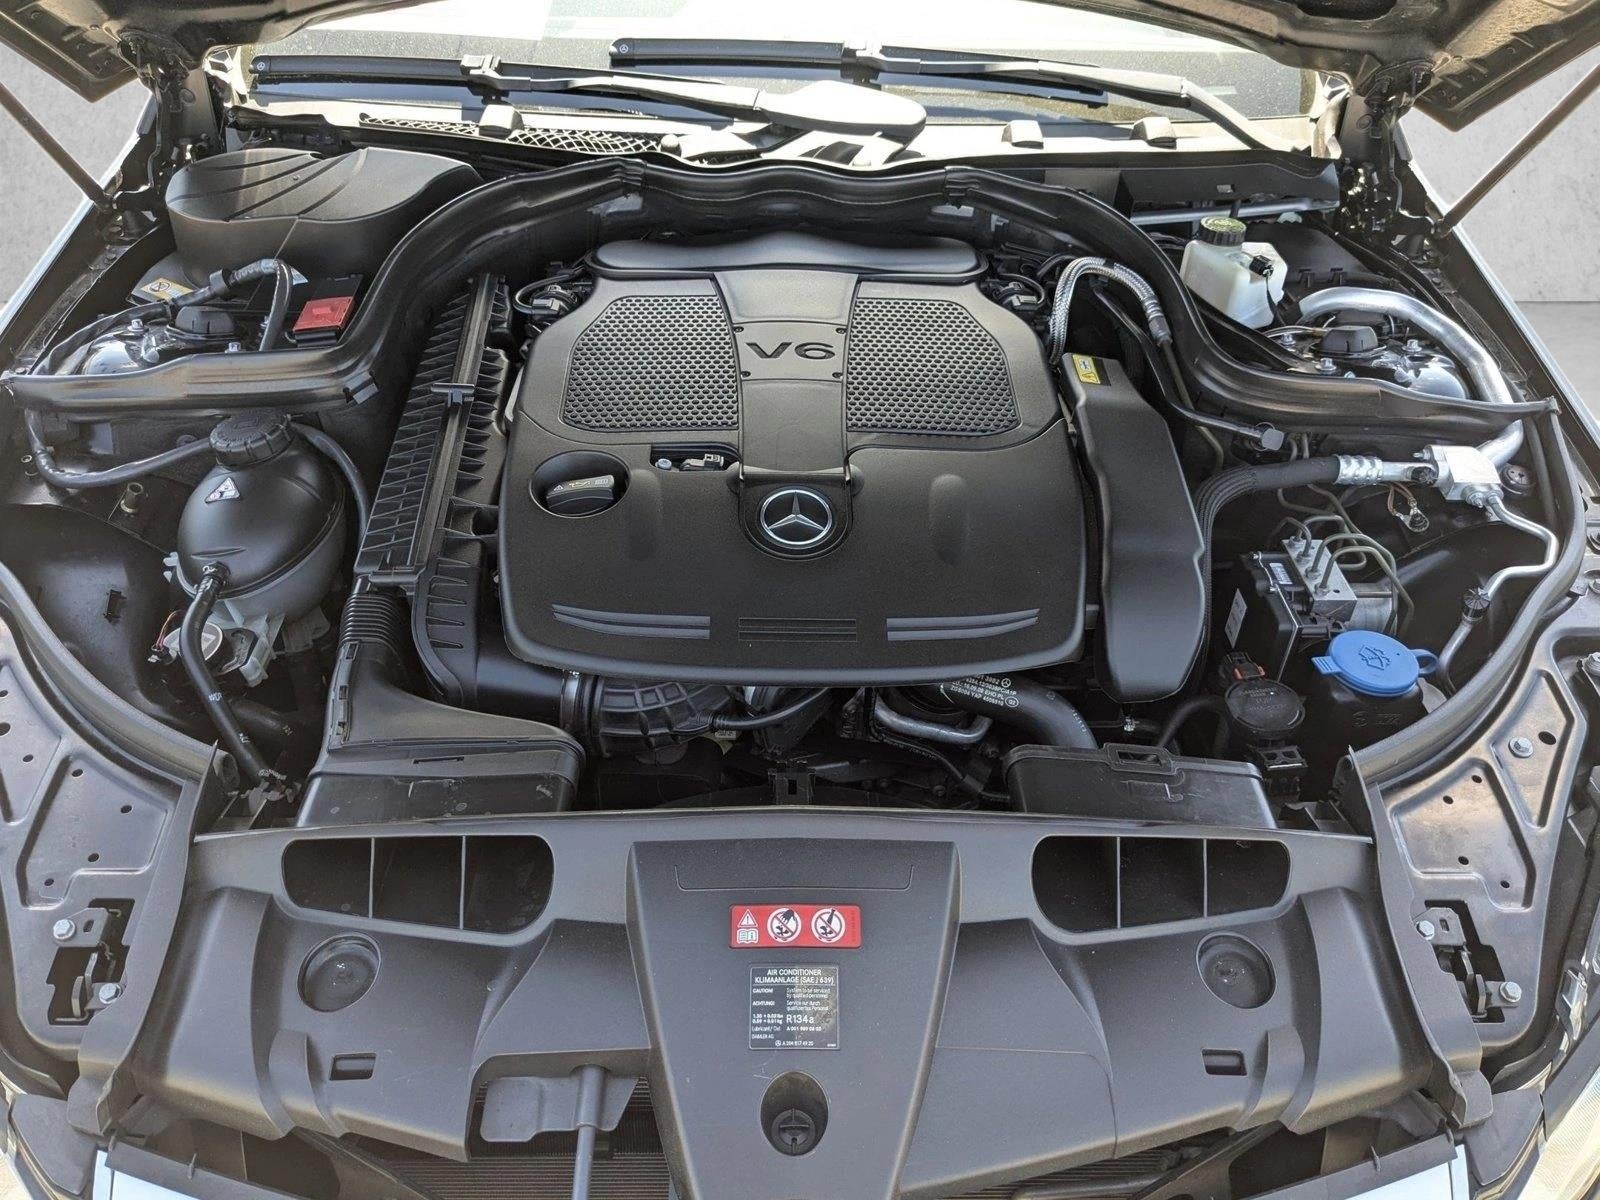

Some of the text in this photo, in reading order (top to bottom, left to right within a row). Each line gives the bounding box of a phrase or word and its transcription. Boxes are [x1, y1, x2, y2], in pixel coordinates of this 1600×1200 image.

[745, 342, 835, 360] V6
[766, 968, 822, 976] AIR CONDITIONER
[754, 976, 799, 984] KLIMAANLAGE
[800, 976, 815, 985] (SAE
[820, 976, 834, 985] 639)
[786, 1014, 815, 1024] R134a
